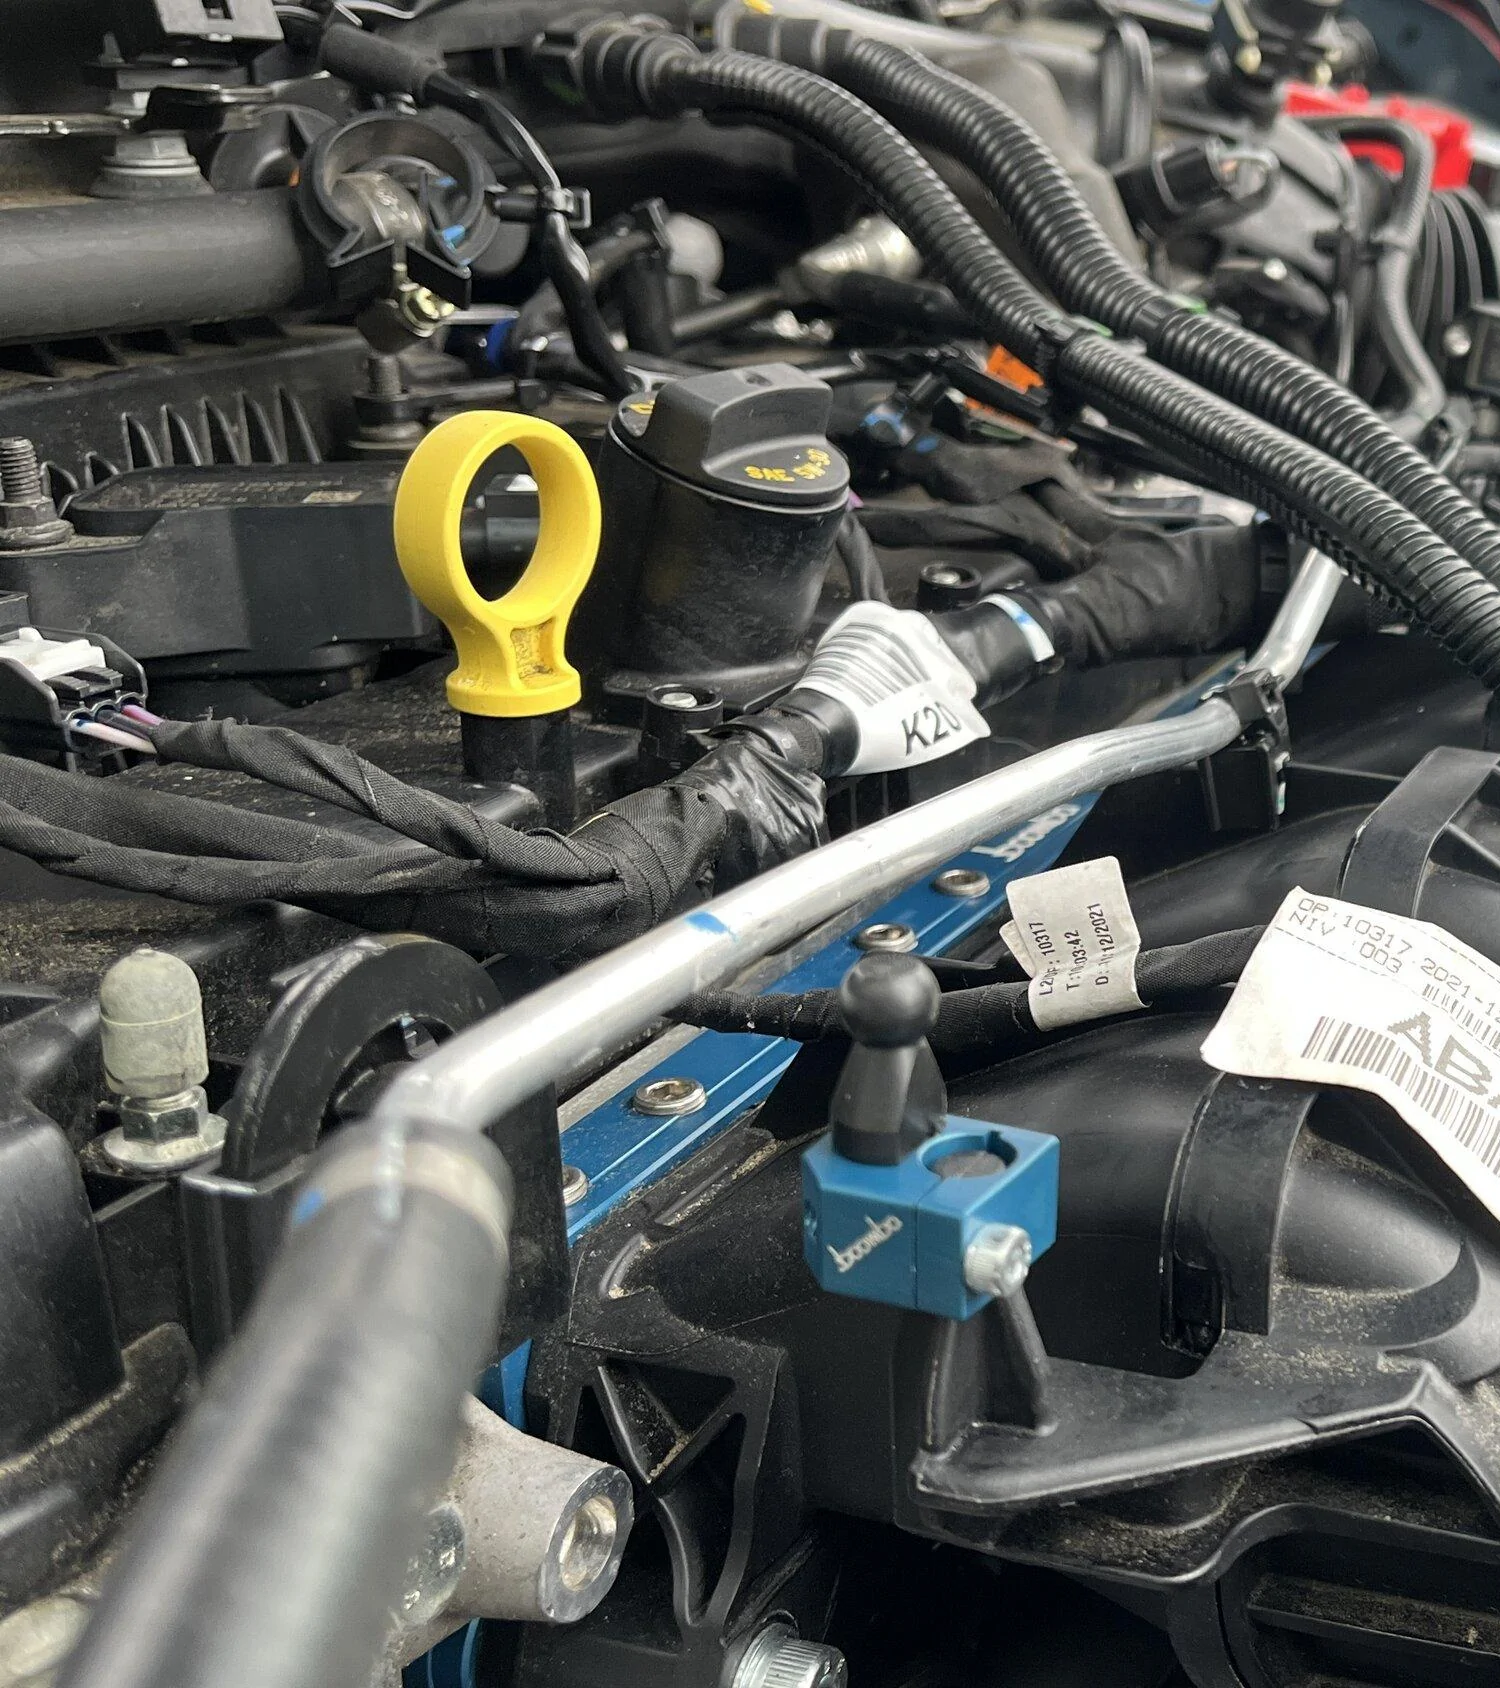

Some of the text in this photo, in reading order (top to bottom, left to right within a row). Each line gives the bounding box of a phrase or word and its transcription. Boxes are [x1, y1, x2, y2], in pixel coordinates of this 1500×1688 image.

[743, 464, 796, 482] SAE
[1028, 922, 1056, 956] 10317
[827, 1214, 904, 1273] boomba
